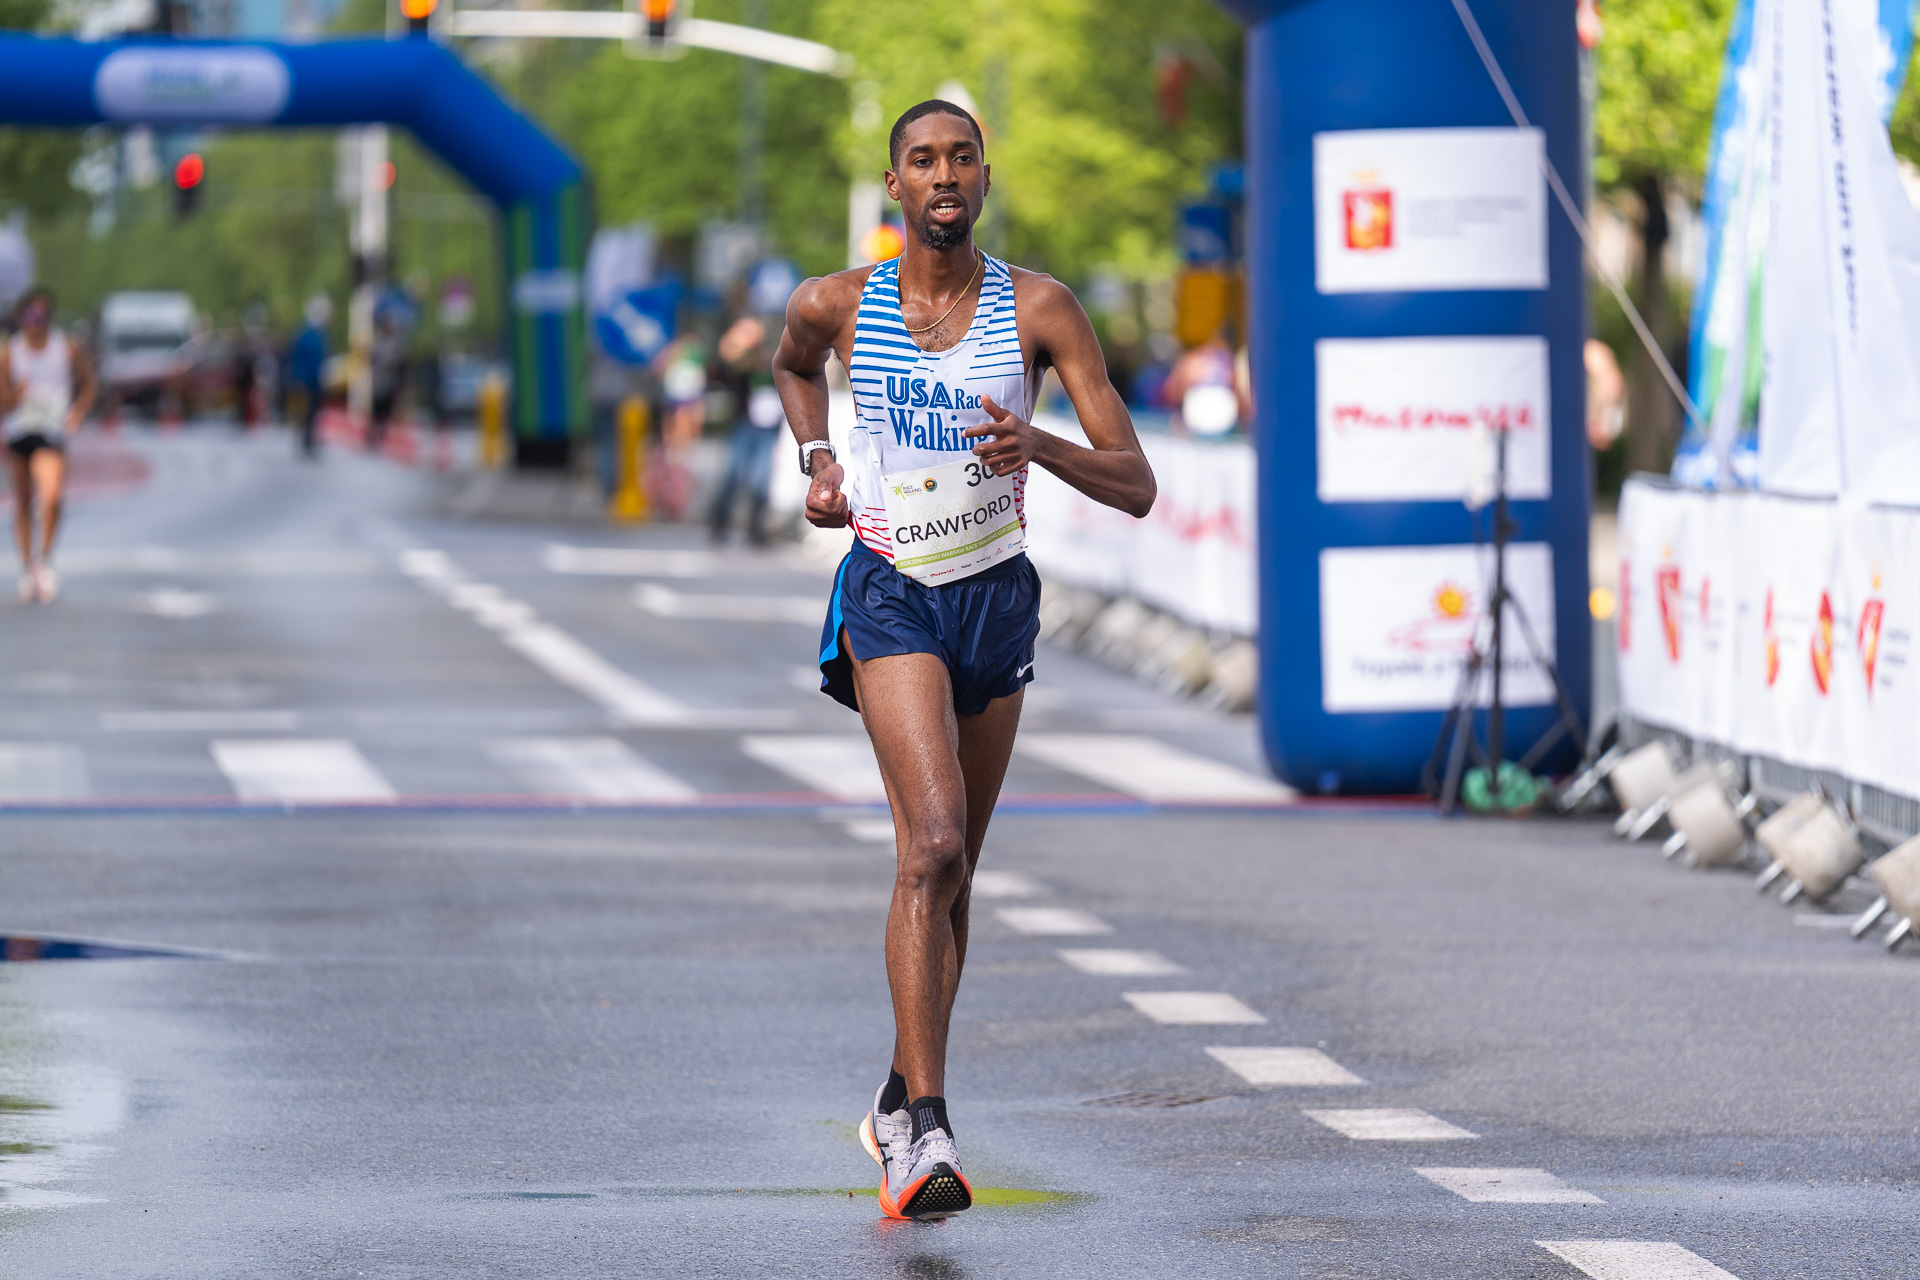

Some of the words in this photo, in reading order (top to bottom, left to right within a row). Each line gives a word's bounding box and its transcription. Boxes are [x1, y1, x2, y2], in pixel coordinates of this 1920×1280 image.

[886, 375, 954, 409] USA
[954, 388, 982, 409] Rac
[887, 407, 988, 452] Walkin
[895, 494, 1012, 545] CRAWFORD
[899, 554, 940, 567] KORZENIOWSKI
[940, 547, 966, 558] WARSAW
[965, 543, 979, 552] RACE
[978, 533, 998, 546] WALKING
[997, 528, 1007, 536] CUP
[1006, 522, 1017, 531] 2025
